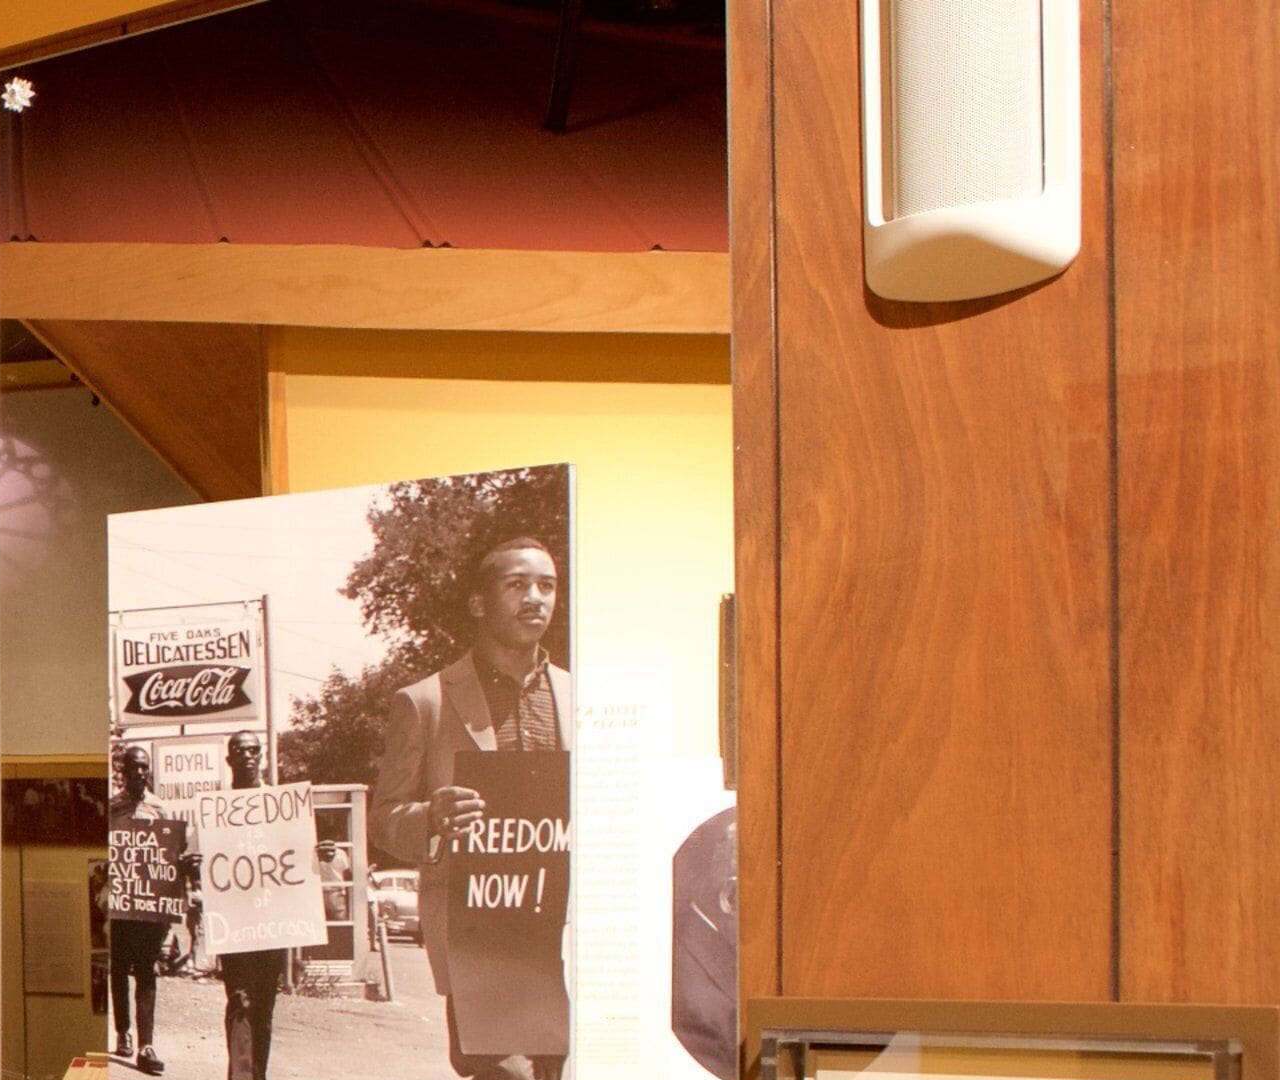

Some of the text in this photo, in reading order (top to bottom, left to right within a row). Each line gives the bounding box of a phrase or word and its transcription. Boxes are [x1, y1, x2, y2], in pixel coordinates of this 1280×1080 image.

[123, 629, 251, 667] DELICATESSEN
[149, 627, 221, 643] FIVE OAKS
[140, 667, 237, 712] Coca-Cola
[164, 754, 214, 773] ROYAL
[200, 788, 313, 829] FREEDOM
[147, 864, 177, 881] WHO
[209, 849, 304, 892] CORE
[112, 878, 155, 896] STILL
[254, 888, 273, 908] of
[207, 911, 316, 946] Democracy
